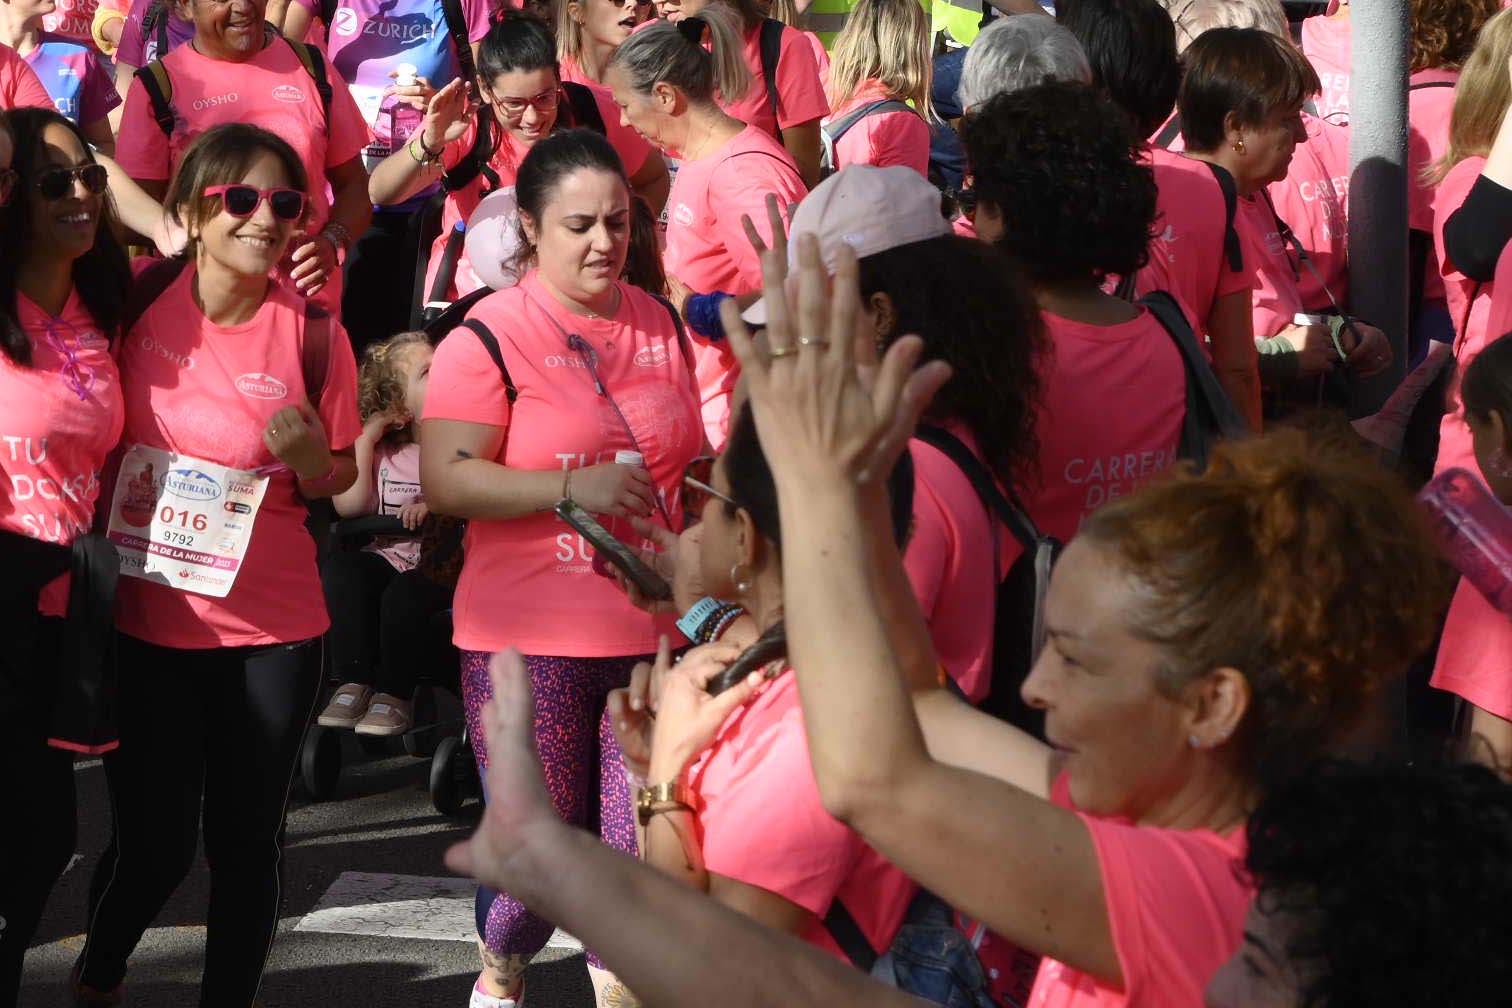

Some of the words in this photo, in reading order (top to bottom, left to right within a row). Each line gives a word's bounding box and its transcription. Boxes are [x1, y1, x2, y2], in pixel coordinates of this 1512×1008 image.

[363, 18, 437, 40] ZURICH
[192, 92, 238, 111] OYSHO
[142, 336, 195, 370] OYSHO
[2, 434, 47, 465] TU
[228, 485, 255, 496] SUMA
[160, 506, 208, 531] 016
[163, 530, 194, 547] 9792
[159, 547, 172, 557] DE
[173, 549, 184, 559] LA
[186, 552, 215, 566] MUJER
